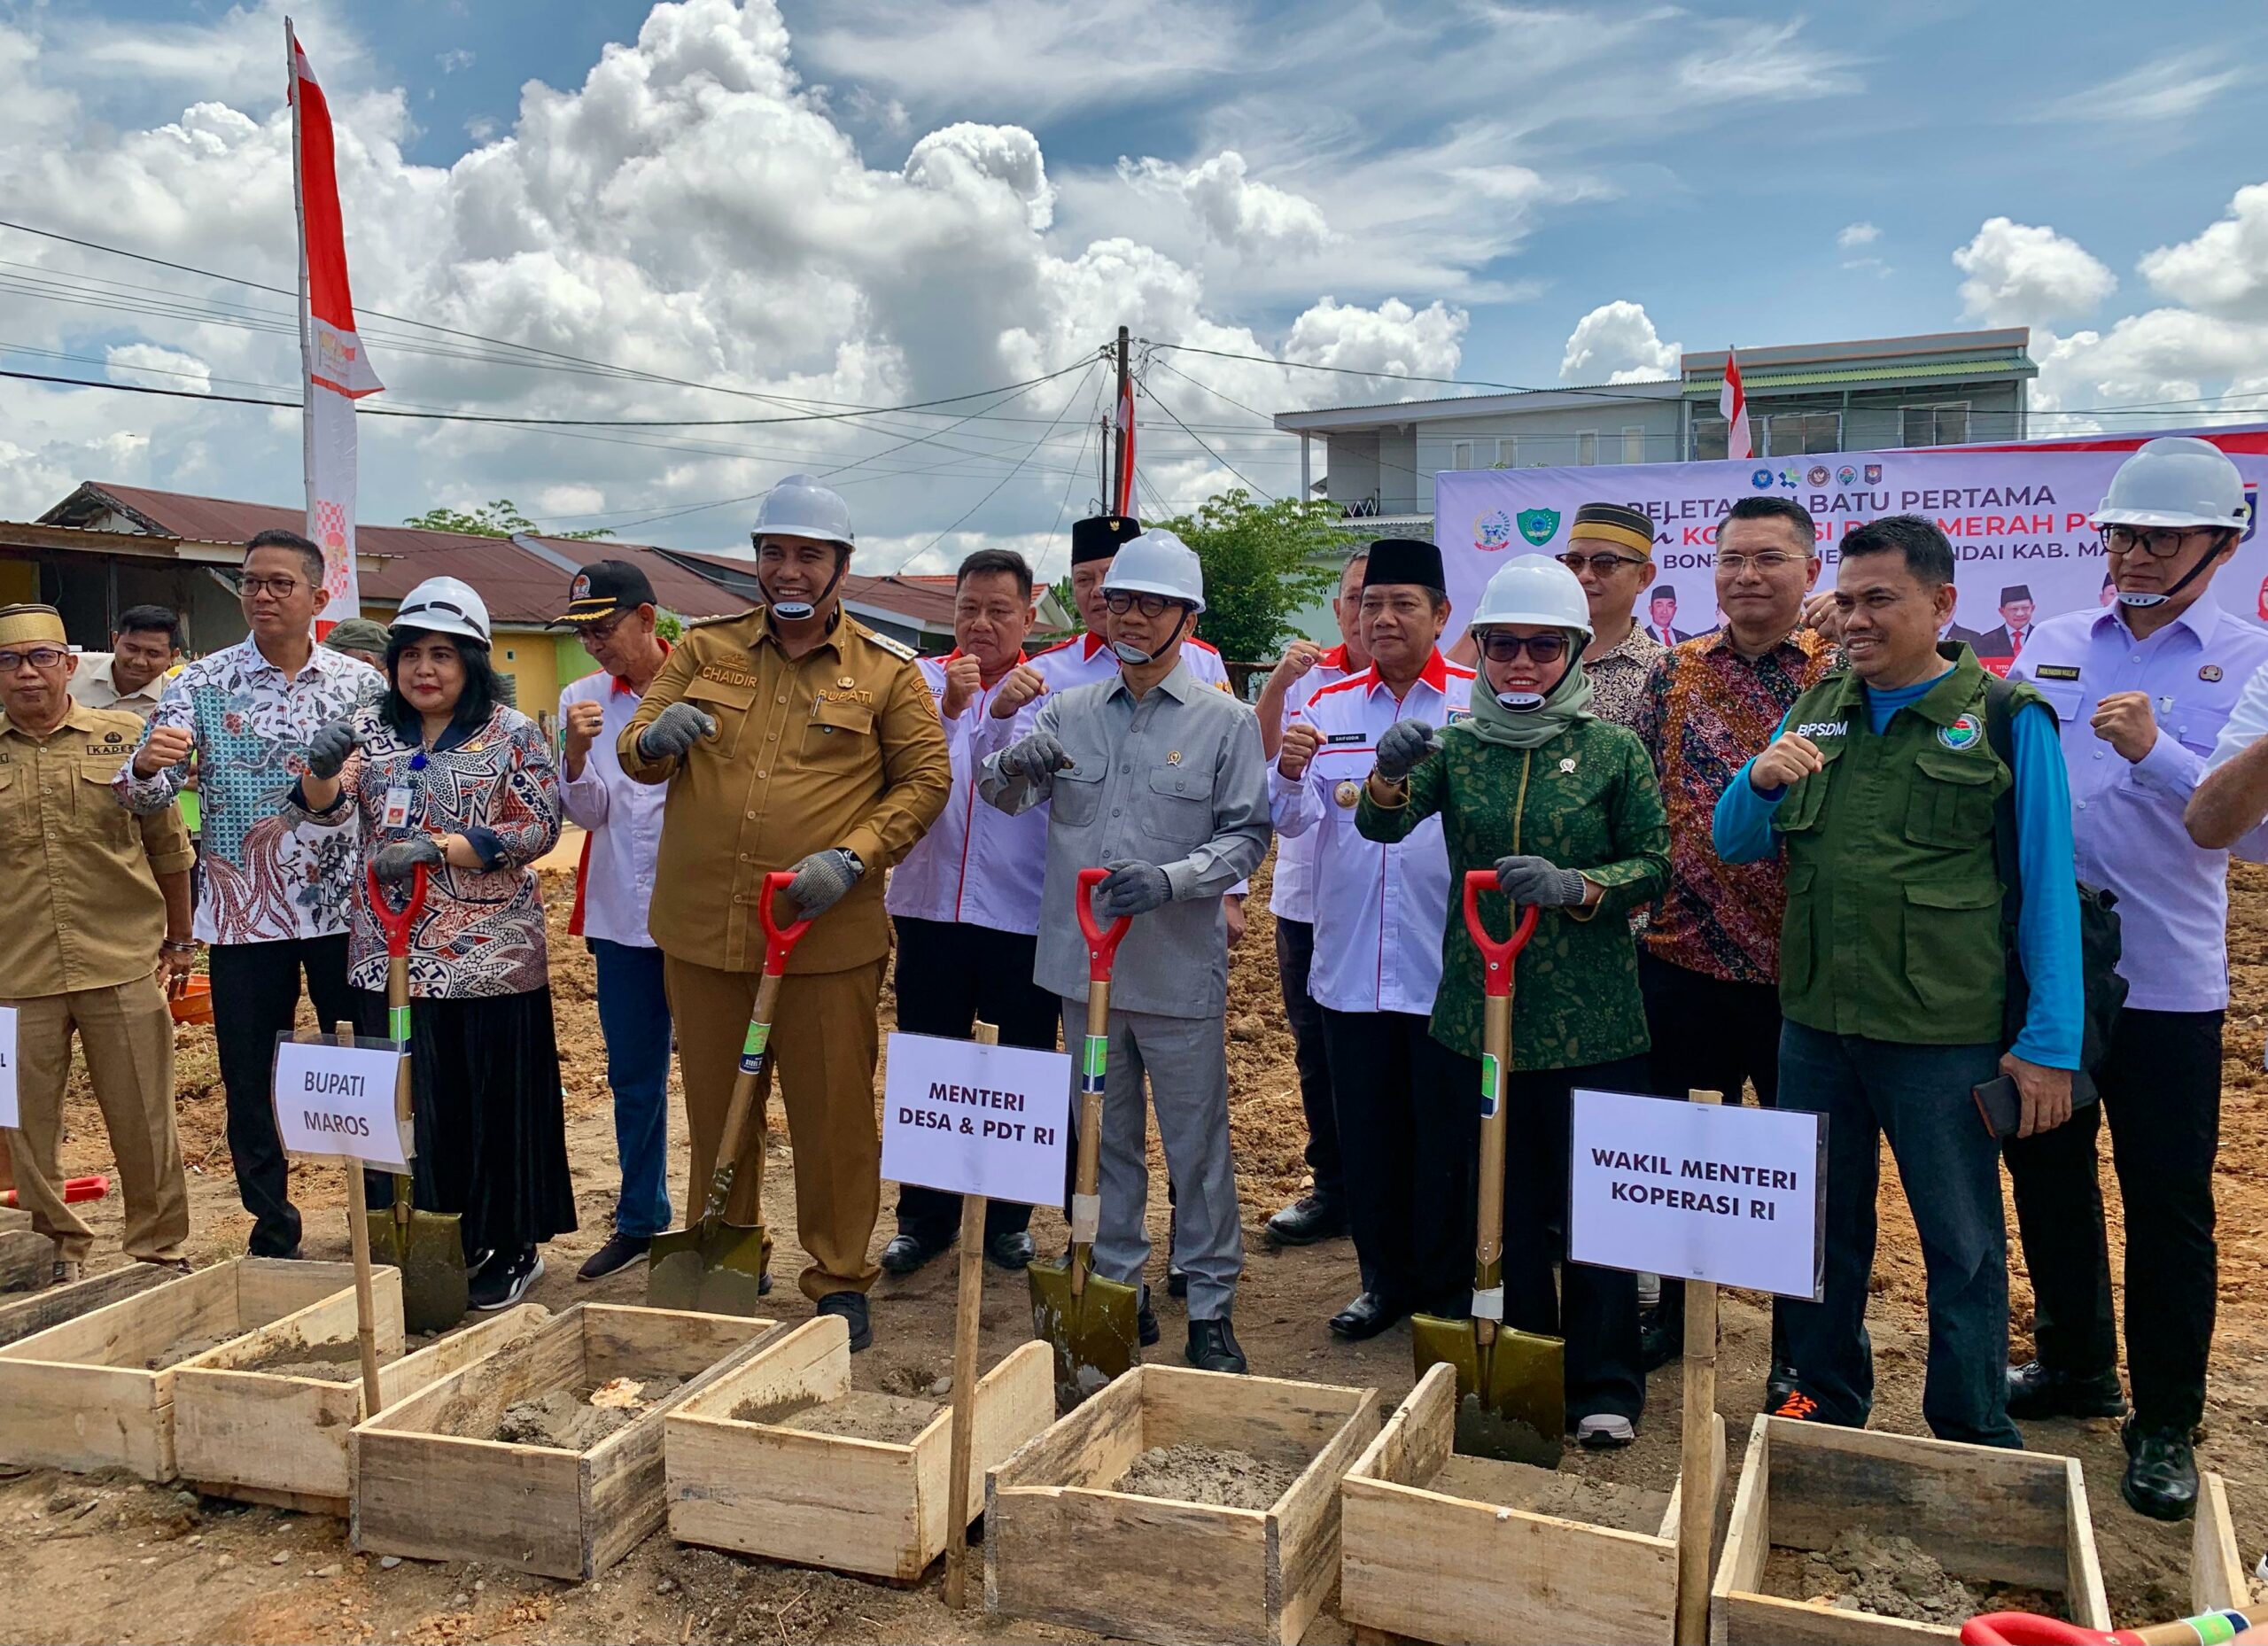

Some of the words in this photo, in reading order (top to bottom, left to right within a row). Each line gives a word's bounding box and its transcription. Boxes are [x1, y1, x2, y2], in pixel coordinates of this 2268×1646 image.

[1810, 491, 1890, 513] BATU
[1901, 485, 2056, 510] PERTAMA
[1938, 514, 2053, 537] MERAH
[2013, 543, 2070, 559] KAB.
[702, 666, 757, 687] CHAIDIR
[817, 689, 873, 703] BUPATI
[1797, 720, 1848, 737] BPSDM
[93, 745, 135, 754] KADES
[305, 1070, 365, 1097] BUPATI
[929, 1083, 1024, 1112] MENTERI
[304, 1110, 369, 1137] MAROS
[899, 1107, 951, 1131] DESA
[959, 1117, 975, 1135] &
[983, 1120, 1026, 1141] PDT
[1033, 1126, 1054, 1145] RI
[1591, 1148, 1673, 1175] WAKIL
[1681, 1159, 1797, 1191] MENTERI
[1612, 1182, 1739, 1216] KOPERASI
[1750, 1200, 1775, 1221] RI
